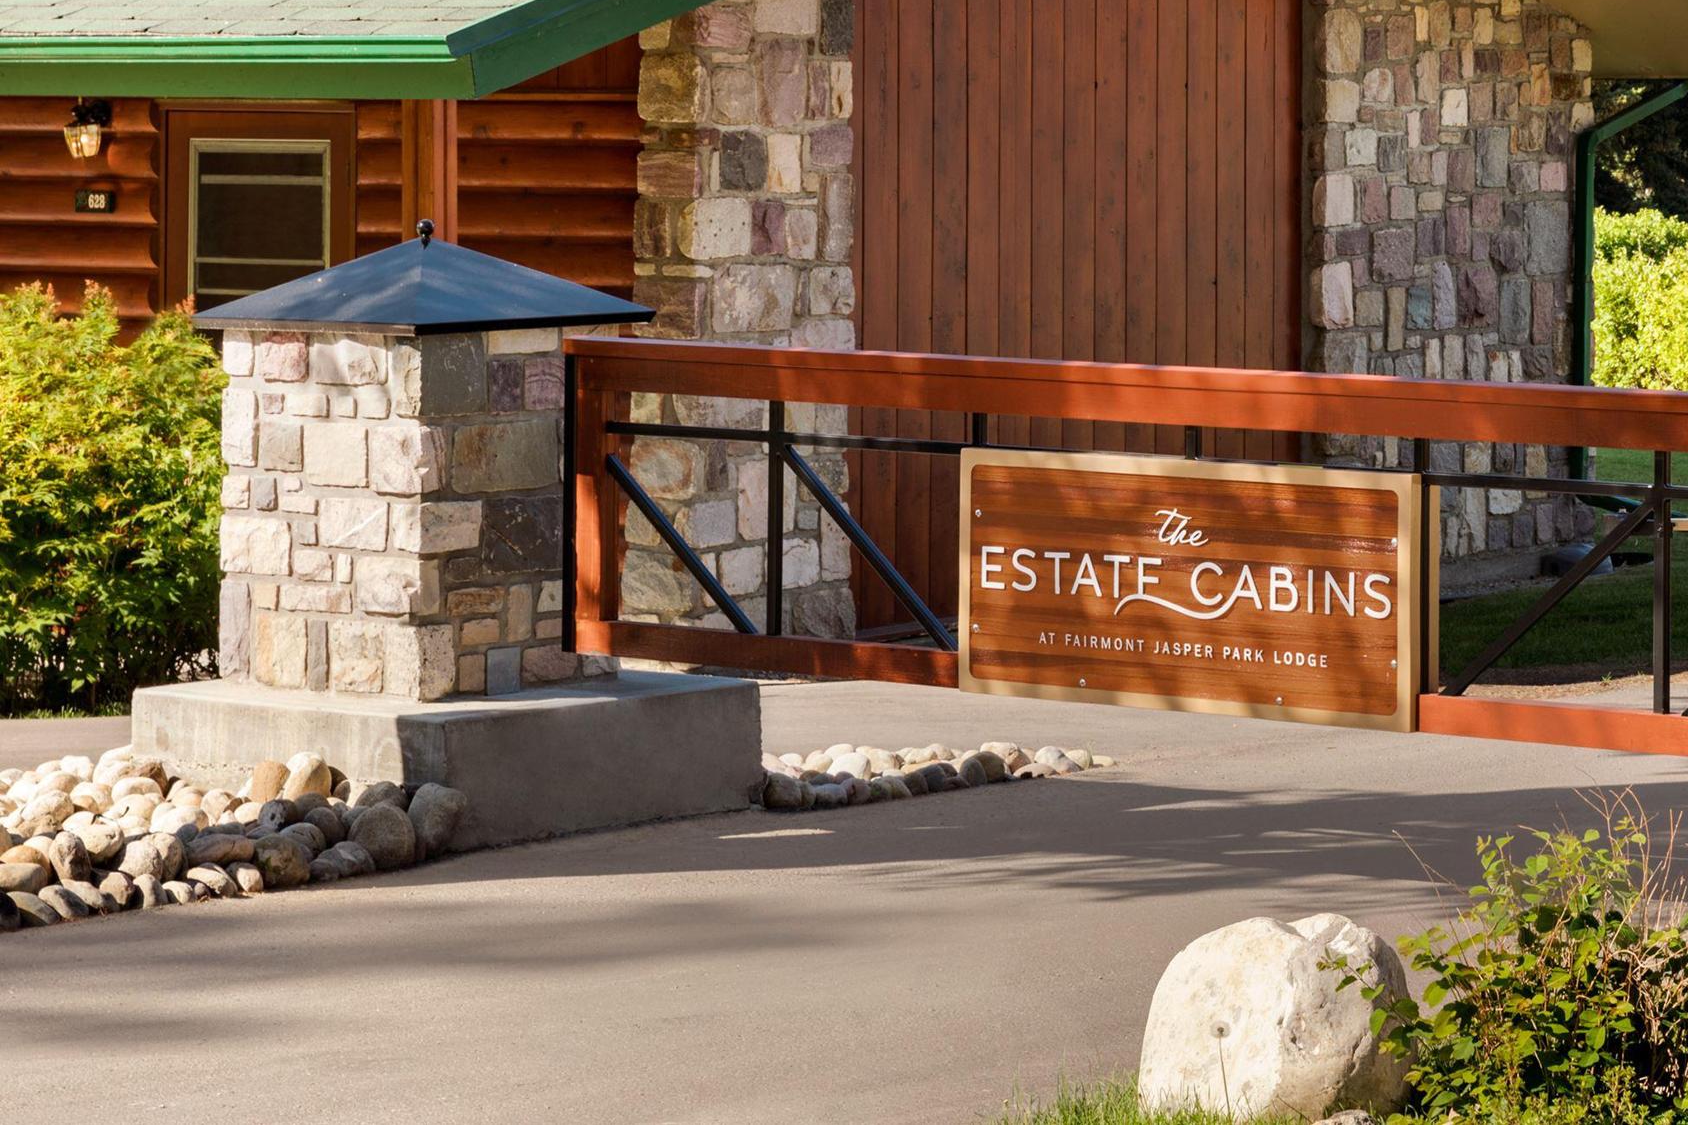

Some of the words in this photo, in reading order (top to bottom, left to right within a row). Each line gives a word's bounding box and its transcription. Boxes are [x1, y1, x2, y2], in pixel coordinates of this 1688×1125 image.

[88, 193, 106, 209] 628
[1154, 507, 1209, 547] the
[980, 545, 1163, 602] ESTATE
[1189, 561, 1392, 620] CABINS
[1038, 631, 1056, 645] AT
[1065, 633, 1145, 653] FAIRMONT
[1153, 640, 1214, 659] JASPER
[1222, 645, 1265, 663] PARK
[1273, 650, 1329, 668] LODGE
